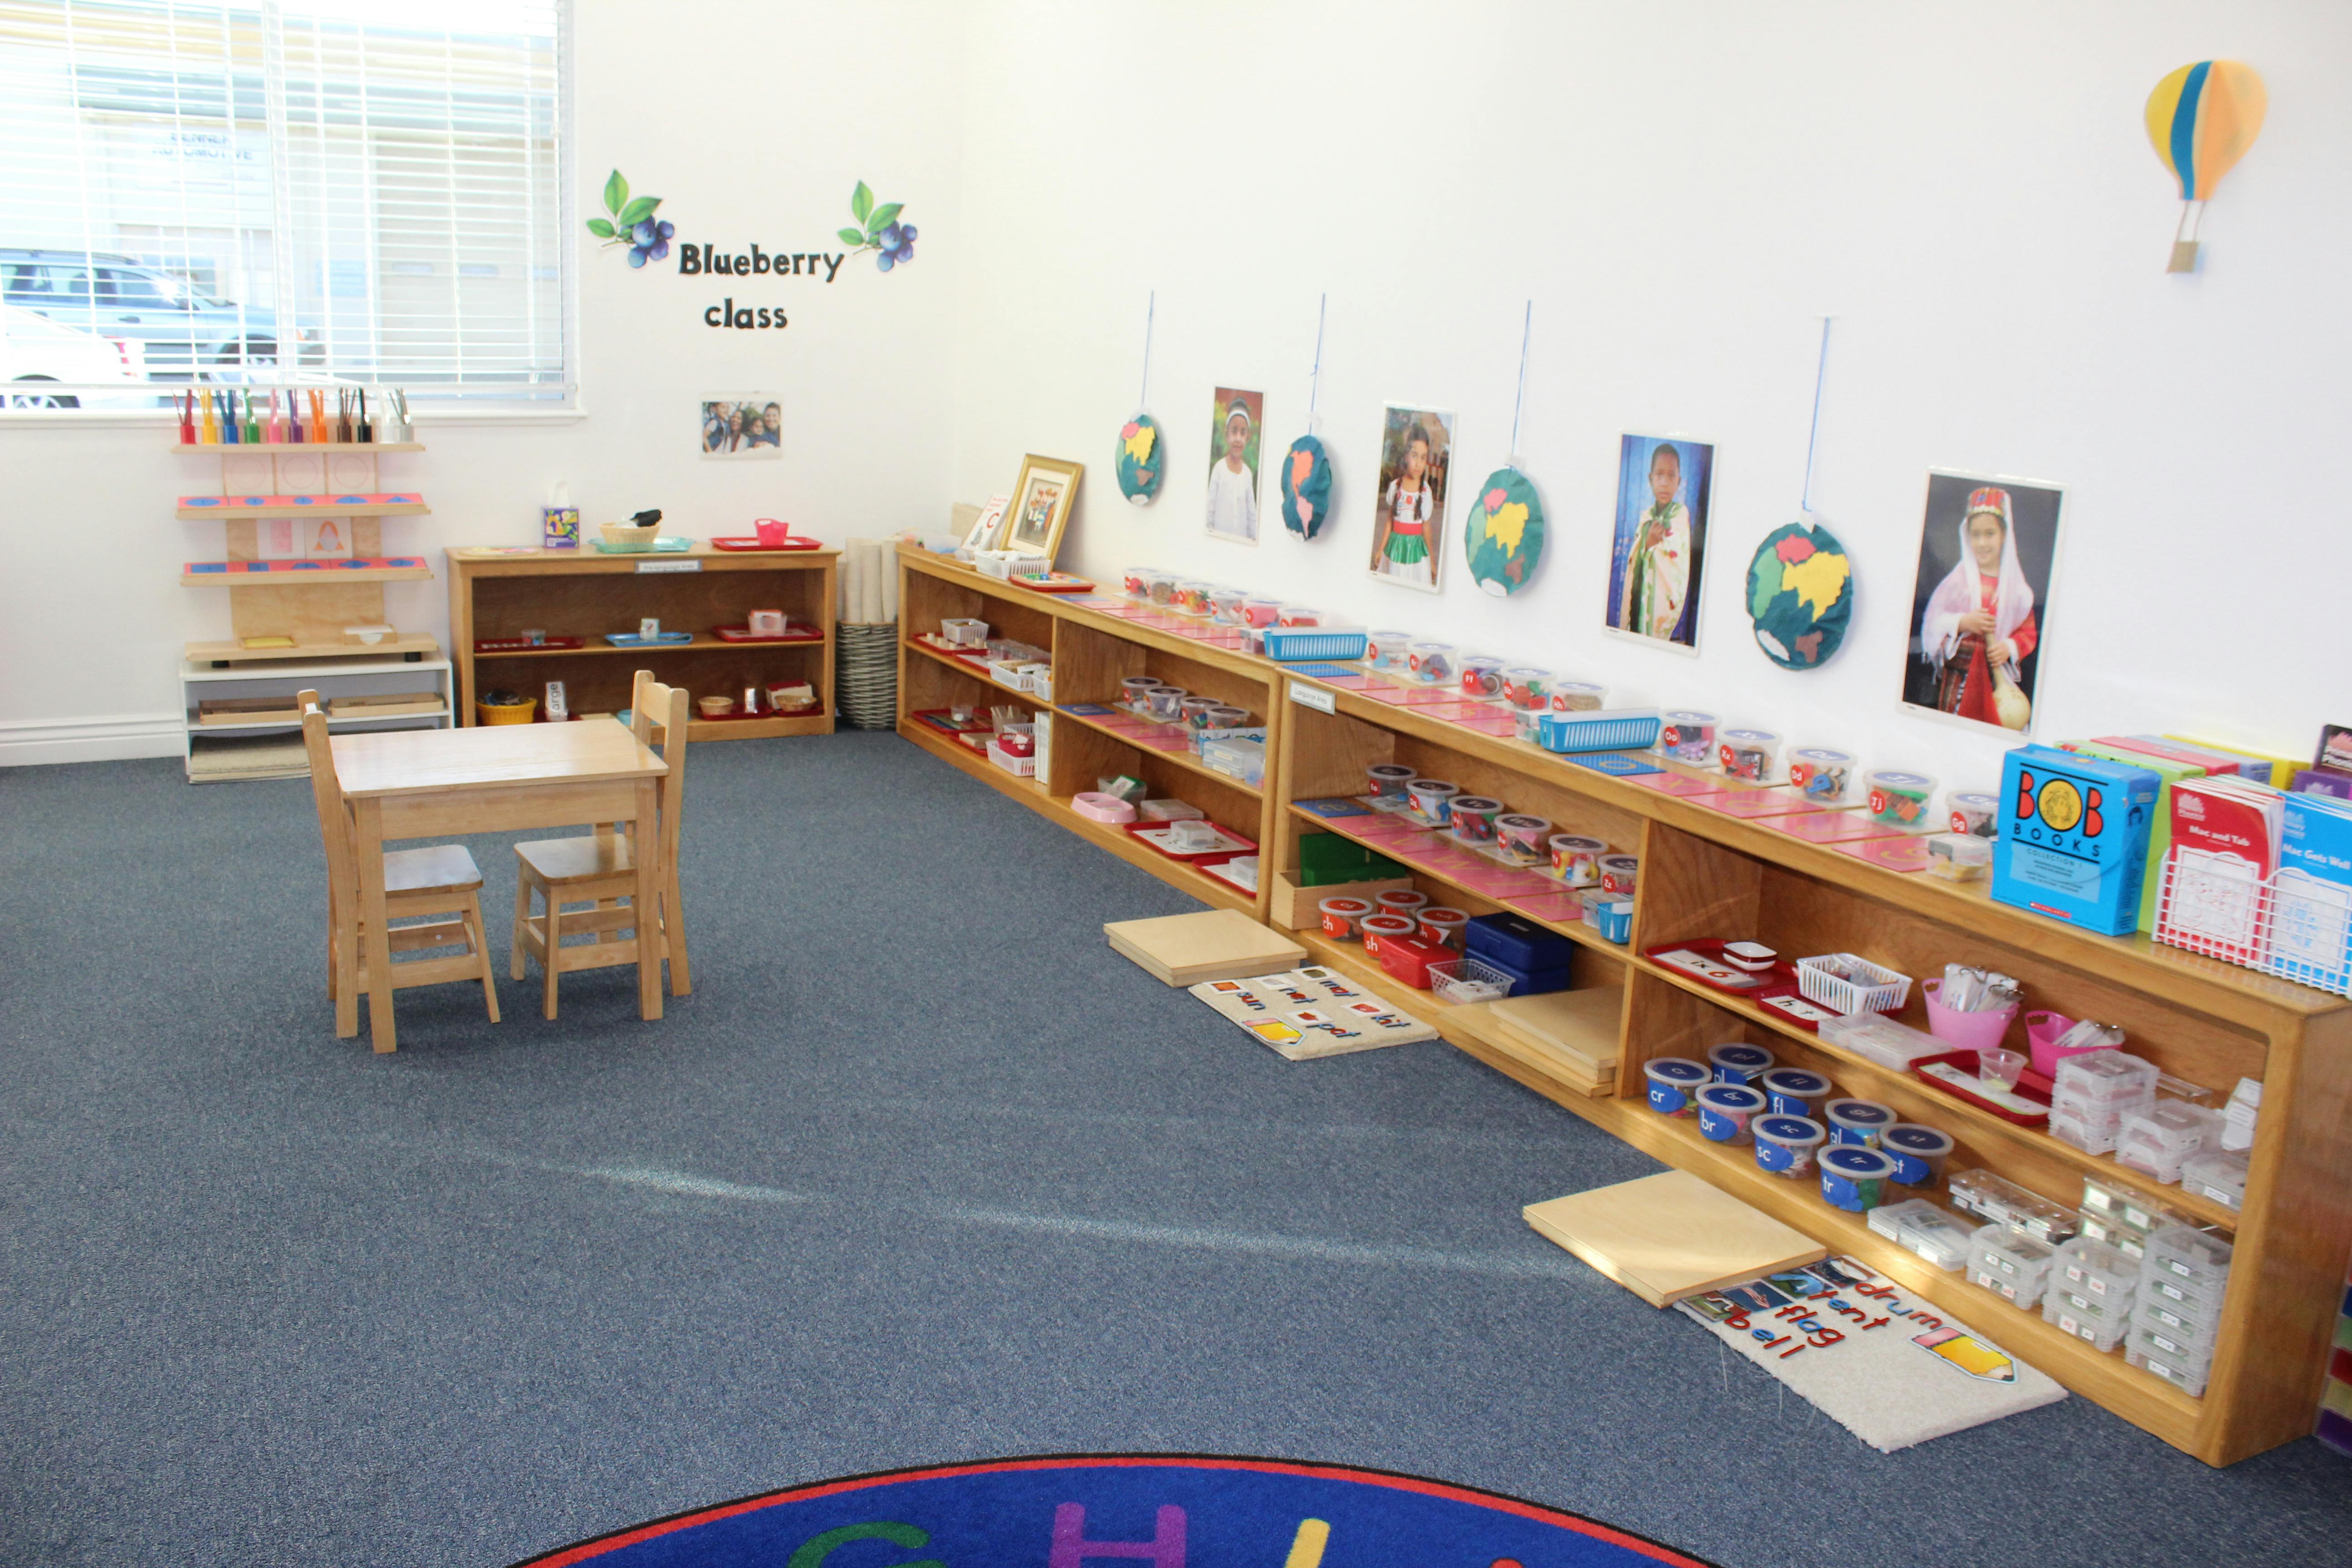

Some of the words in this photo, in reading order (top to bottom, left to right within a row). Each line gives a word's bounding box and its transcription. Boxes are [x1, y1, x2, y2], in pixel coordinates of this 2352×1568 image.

[152, 147, 252, 160] AUTOMOTVE
[679, 243, 845, 283] Blueberry
[704, 297, 788, 328] class
[1664, 731, 1678, 741] Oo
[1721, 750, 1731, 761] Xx
[1792, 766, 1803, 781] Dd
[1872, 797, 1883, 811] Jj
[2016, 770, 2103, 838] BOB
[1952, 817, 1965, 831] Gg
[2014, 823, 2101, 857] BOOKS
[2189, 825, 2210, 837] Mac
[2210, 831, 2230, 842] and
[2231, 834, 2250, 847] Tab
[2027, 848, 2075, 866] COLLECTION
[2283, 843, 2303, 857] Mac
[1322, 916, 1333, 931] ch
[1366, 936, 1378, 952] sh
[1236, 991, 1266, 1011] sun
[1370, 1014, 1411, 1028] kit
[1650, 1090, 1666, 1103] cr
[1723, 1092, 1743, 1102] br
[1773, 1096, 1784, 1114] fl
[1700, 1110, 1716, 1133] br
[1757, 1145, 1771, 1162] sc
[1822, 1176, 1834, 1193] tr
[1807, 1290, 1890, 1331] tent
[1855, 1282, 1942, 1330] drum
[1724, 1310, 1806, 1359] bell
[1774, 1305, 1845, 1348] flag
